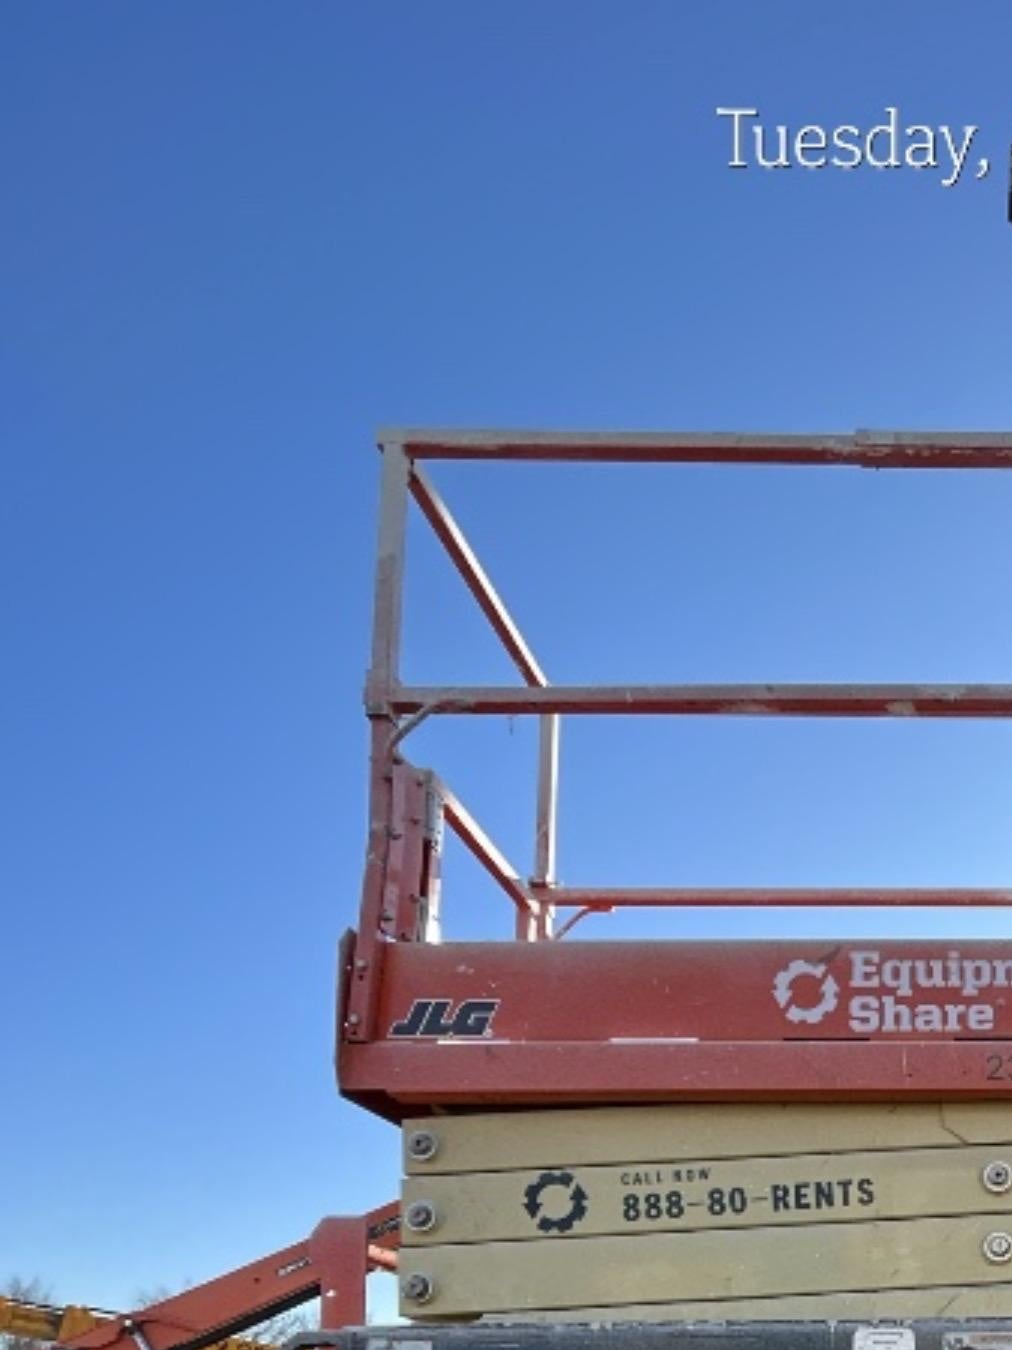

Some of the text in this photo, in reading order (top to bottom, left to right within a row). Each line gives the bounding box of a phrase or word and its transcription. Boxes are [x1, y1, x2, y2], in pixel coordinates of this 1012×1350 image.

[386, 998, 501, 1039] JLG
[849, 995, 994, 1033] Share
[620, 1171, 664, 1186] CALL
